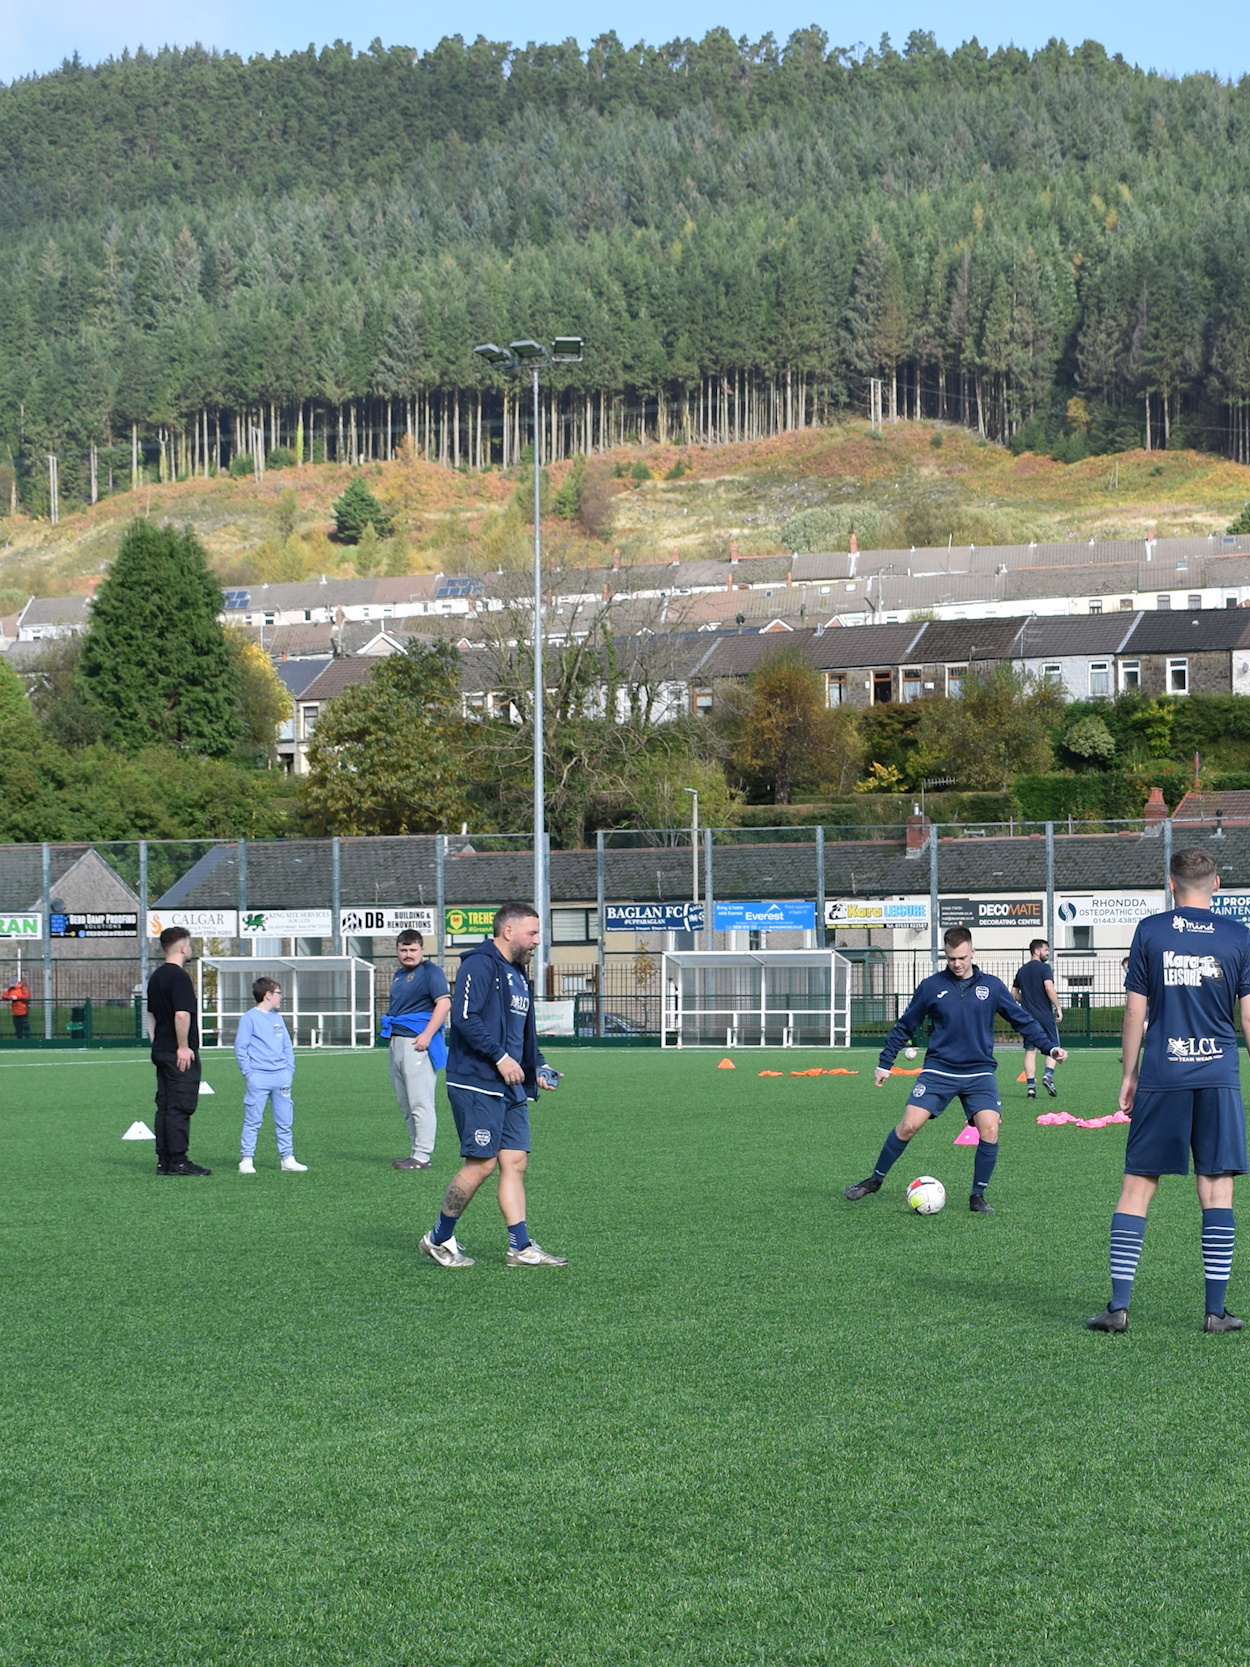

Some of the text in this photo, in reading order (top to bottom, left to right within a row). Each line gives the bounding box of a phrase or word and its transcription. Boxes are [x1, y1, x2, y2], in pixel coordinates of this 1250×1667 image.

[1093, 899, 1147, 907] RHONDDA
[394, 911, 425, 919] BUILDING
[607, 907, 663, 919] BAGLAN
[665, 906, 683, 918] FC
[746, 912, 785, 920] Everest
[847, 904, 927, 918] Kara LEISURE
[979, 904, 1041, 916] DECOMATE
[171, 913, 224, 925] CALGAR
[365, 911, 384, 929] DB
[468, 912, 497, 924] TREHE
[387, 920, 431, 929] RENOVATIONS
[1163, 950, 1200, 969] Kara
[1163, 968, 1202, 987] LEISURE
[1188, 1038, 1223, 1056] LCL
